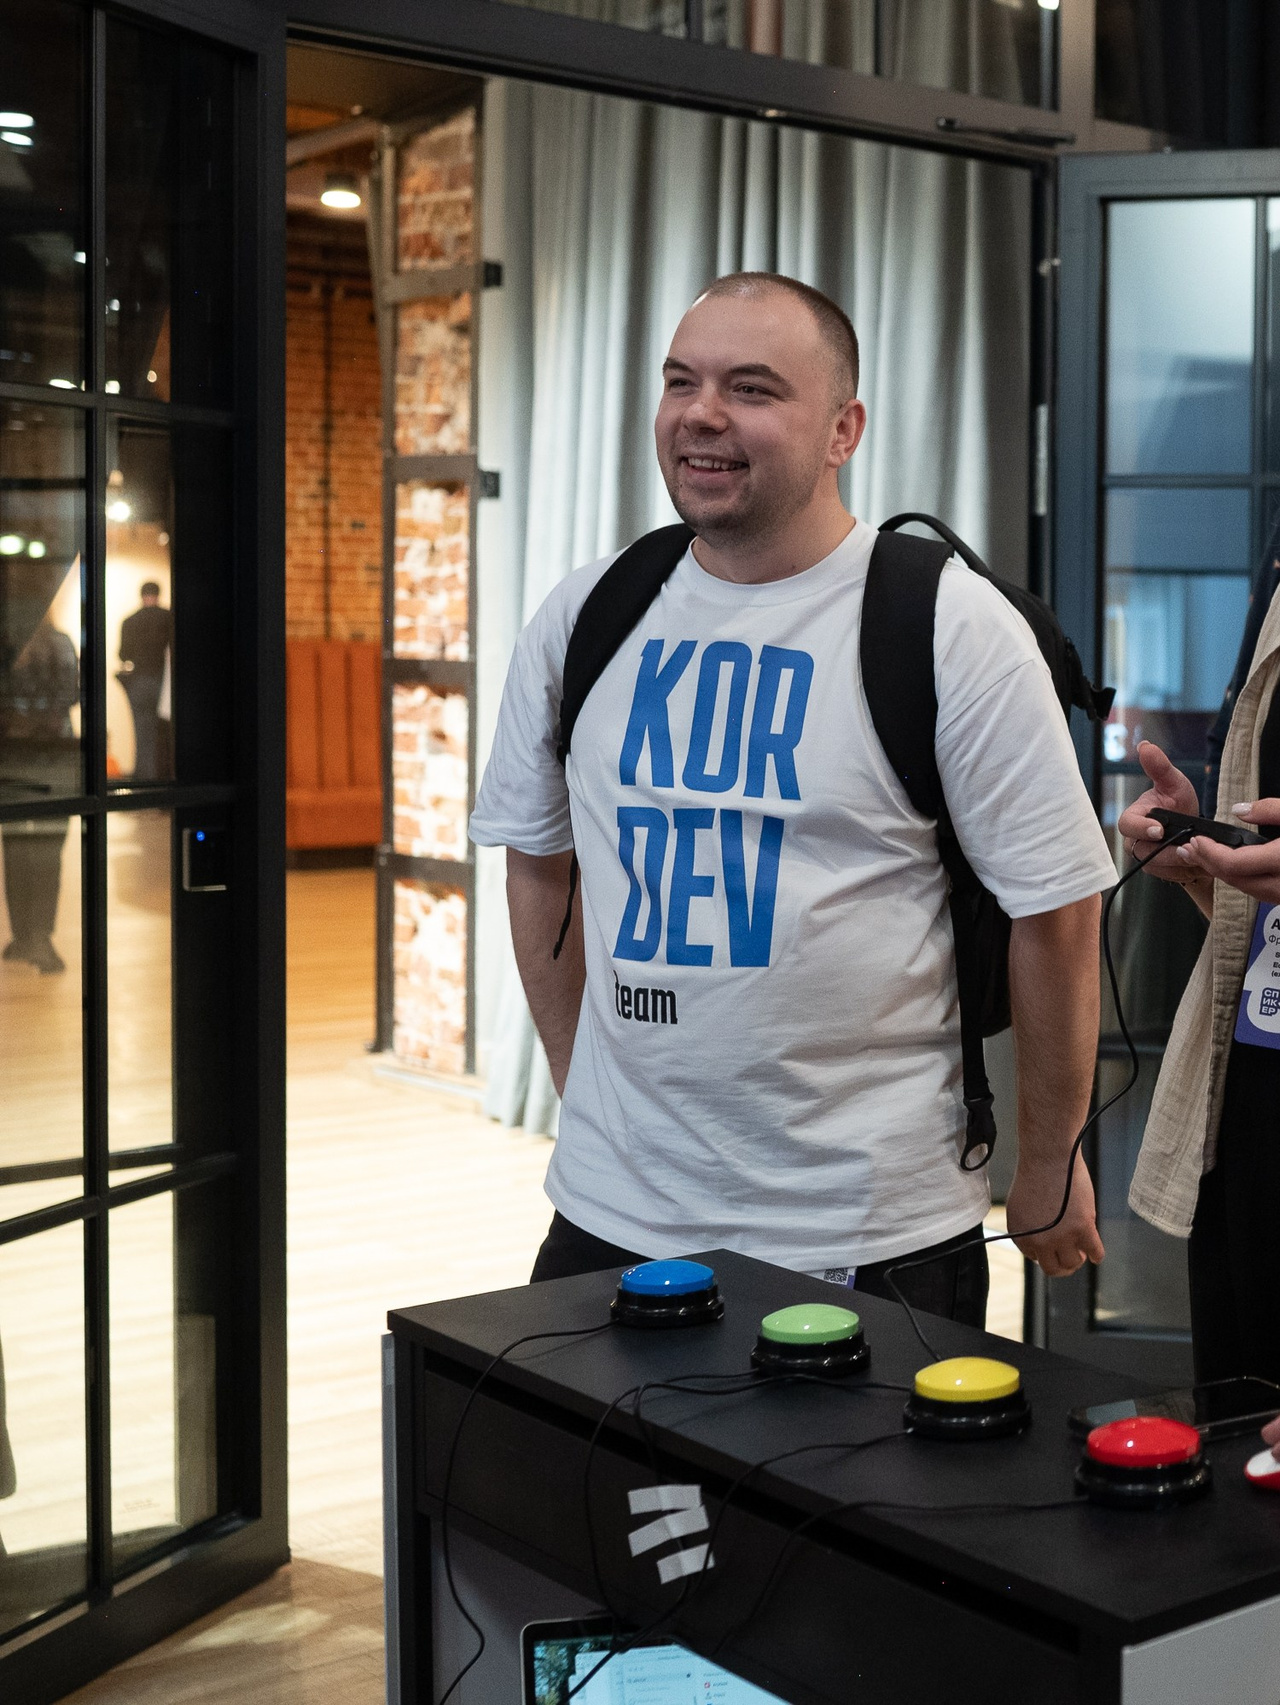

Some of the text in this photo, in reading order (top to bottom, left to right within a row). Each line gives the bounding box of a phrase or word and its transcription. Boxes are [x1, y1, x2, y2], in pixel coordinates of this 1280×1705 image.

[619, 638, 814, 800] KOR
[612, 806, 785, 967] DEV
[612, 969, 678, 1025] team
